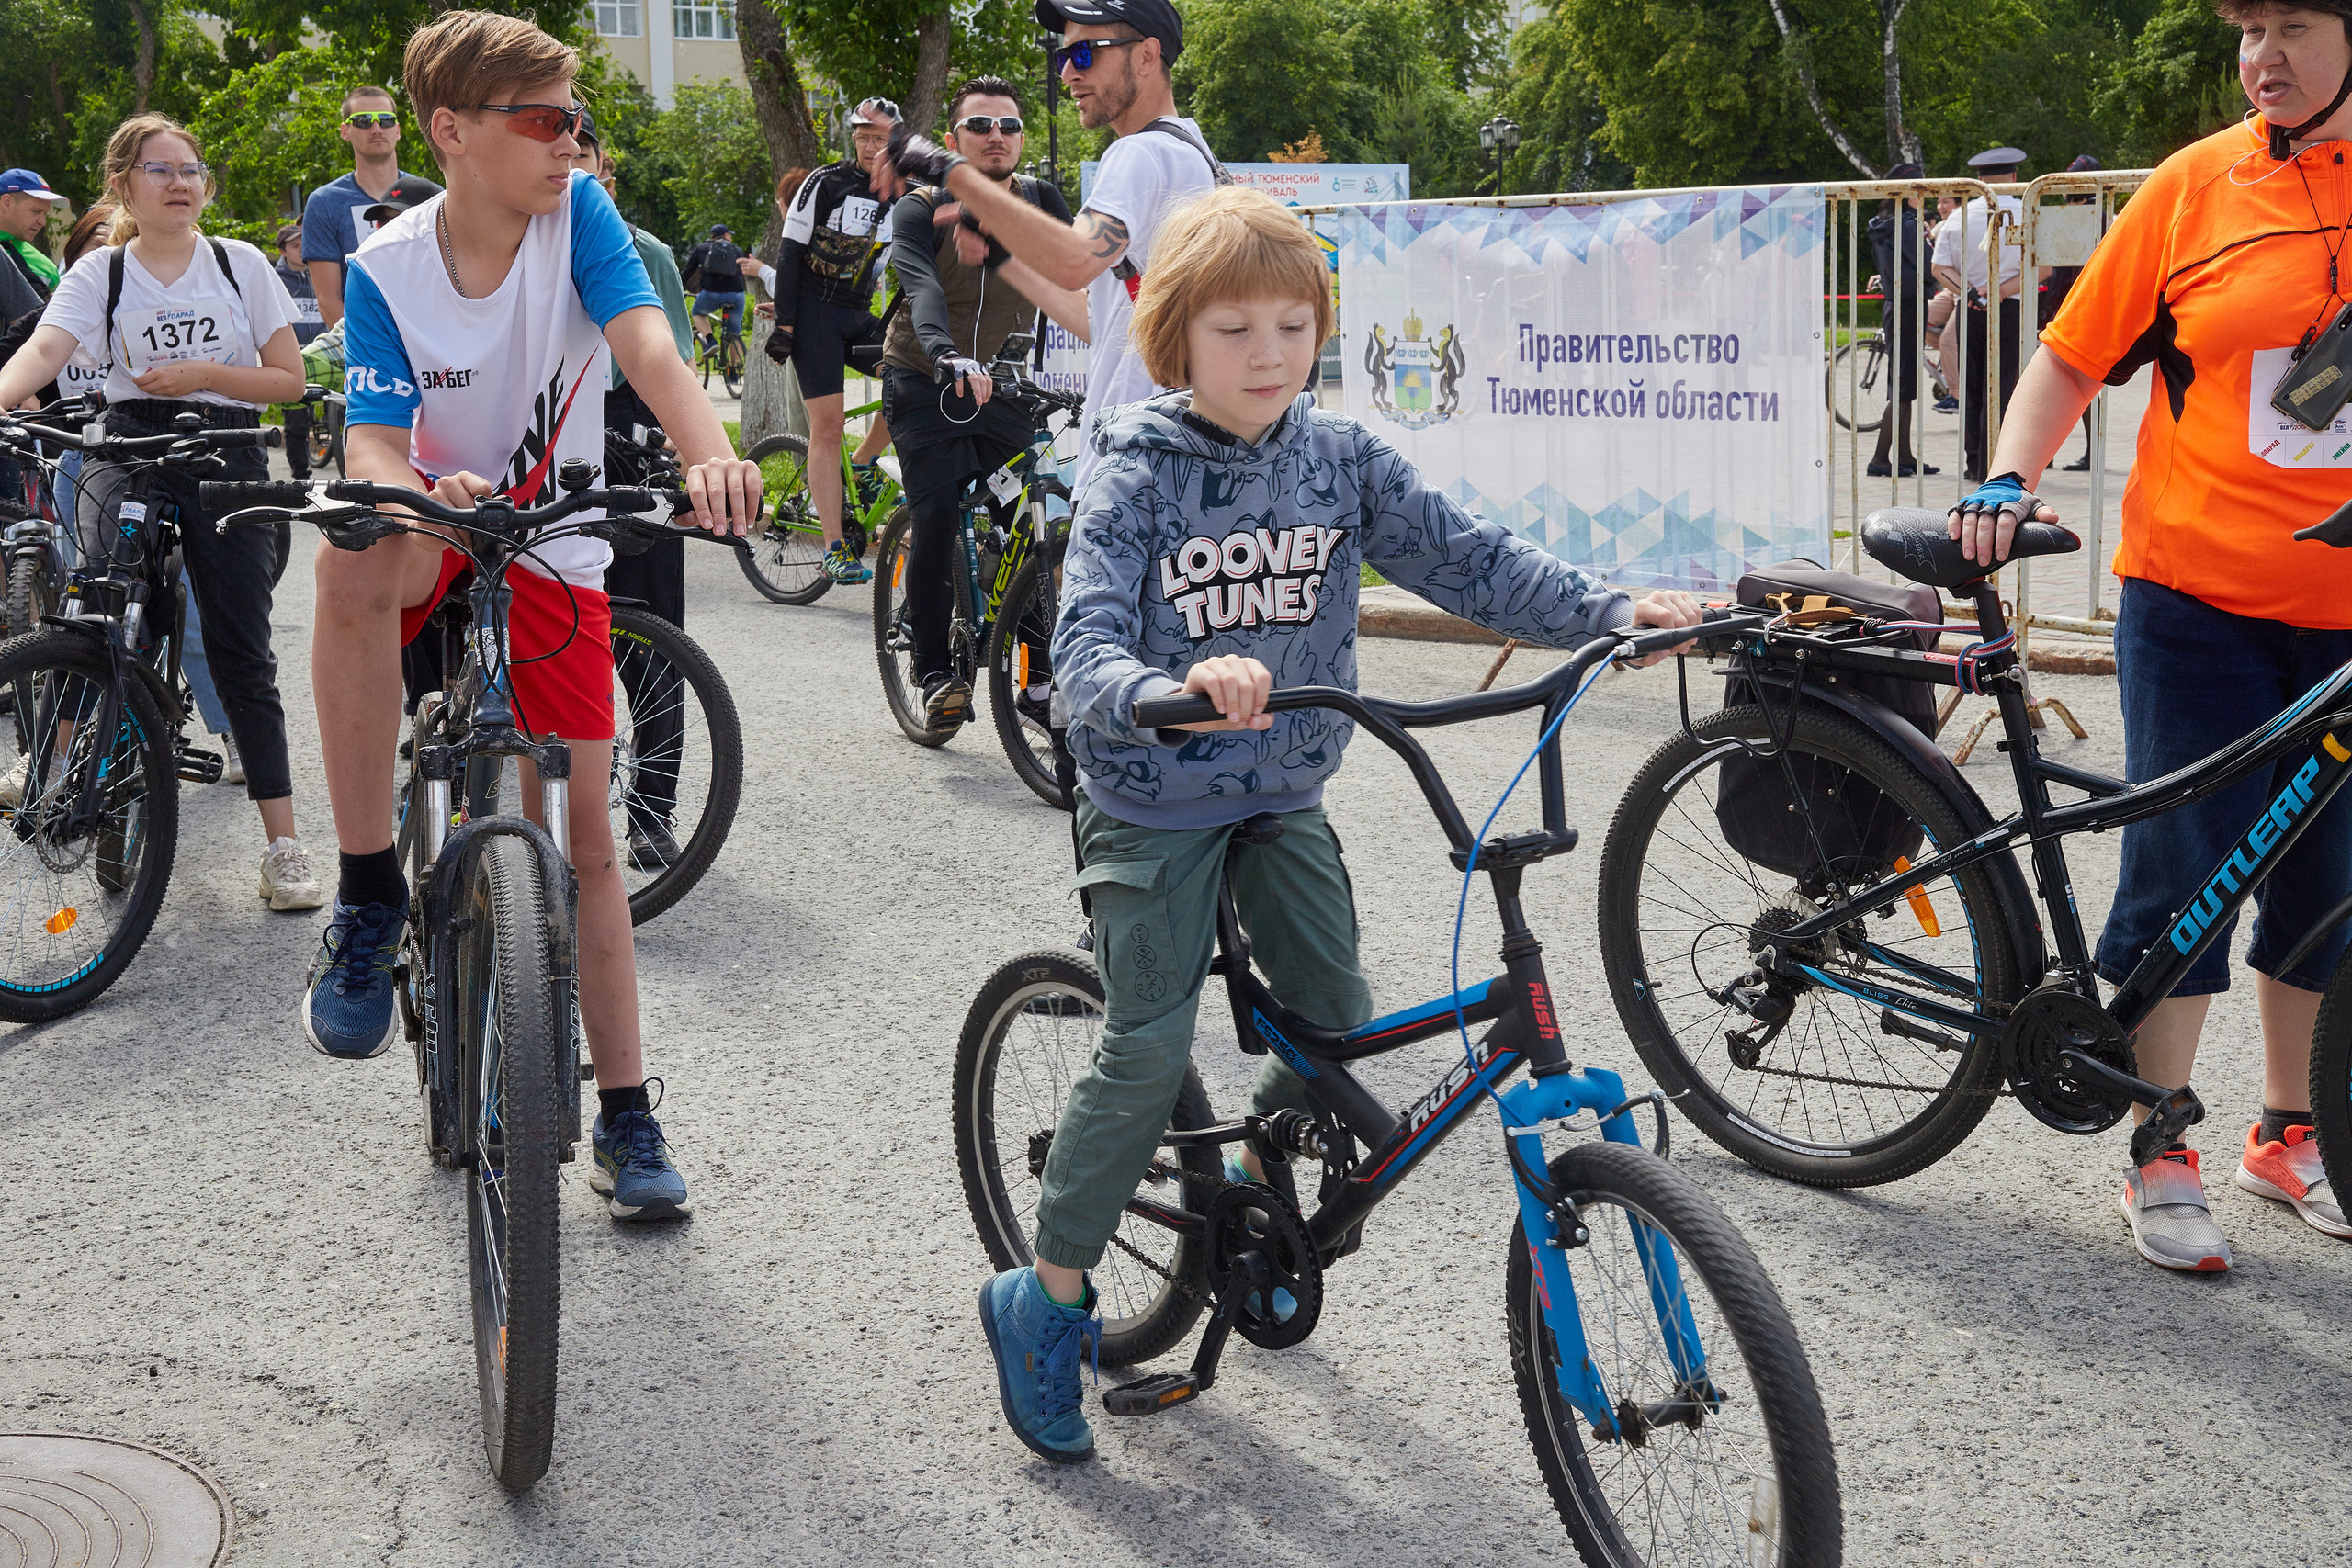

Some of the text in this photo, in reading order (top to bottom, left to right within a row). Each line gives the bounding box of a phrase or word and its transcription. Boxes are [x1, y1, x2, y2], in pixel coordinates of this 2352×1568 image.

[1258, 172, 1320, 184] ТЮМЕНСКИЙ
[852, 206, 886, 225] 126
[142, 316, 220, 351] 1372
[1519, 323, 1740, 373] Правительство
[1487, 376, 1645, 418] Тюменской
[1655, 379, 1779, 421] области
[985, 525, 1023, 623] WELT
[1159, 525, 1344, 600] LOONEY
[1173, 574, 1322, 639] TUNES
[627, 631, 653, 647] STERN
[2170, 754, 2320, 955] OUTLEAP
[1862, 987, 1918, 1010] BLISS Elite
[1256, 1017, 1295, 1061] FS250
